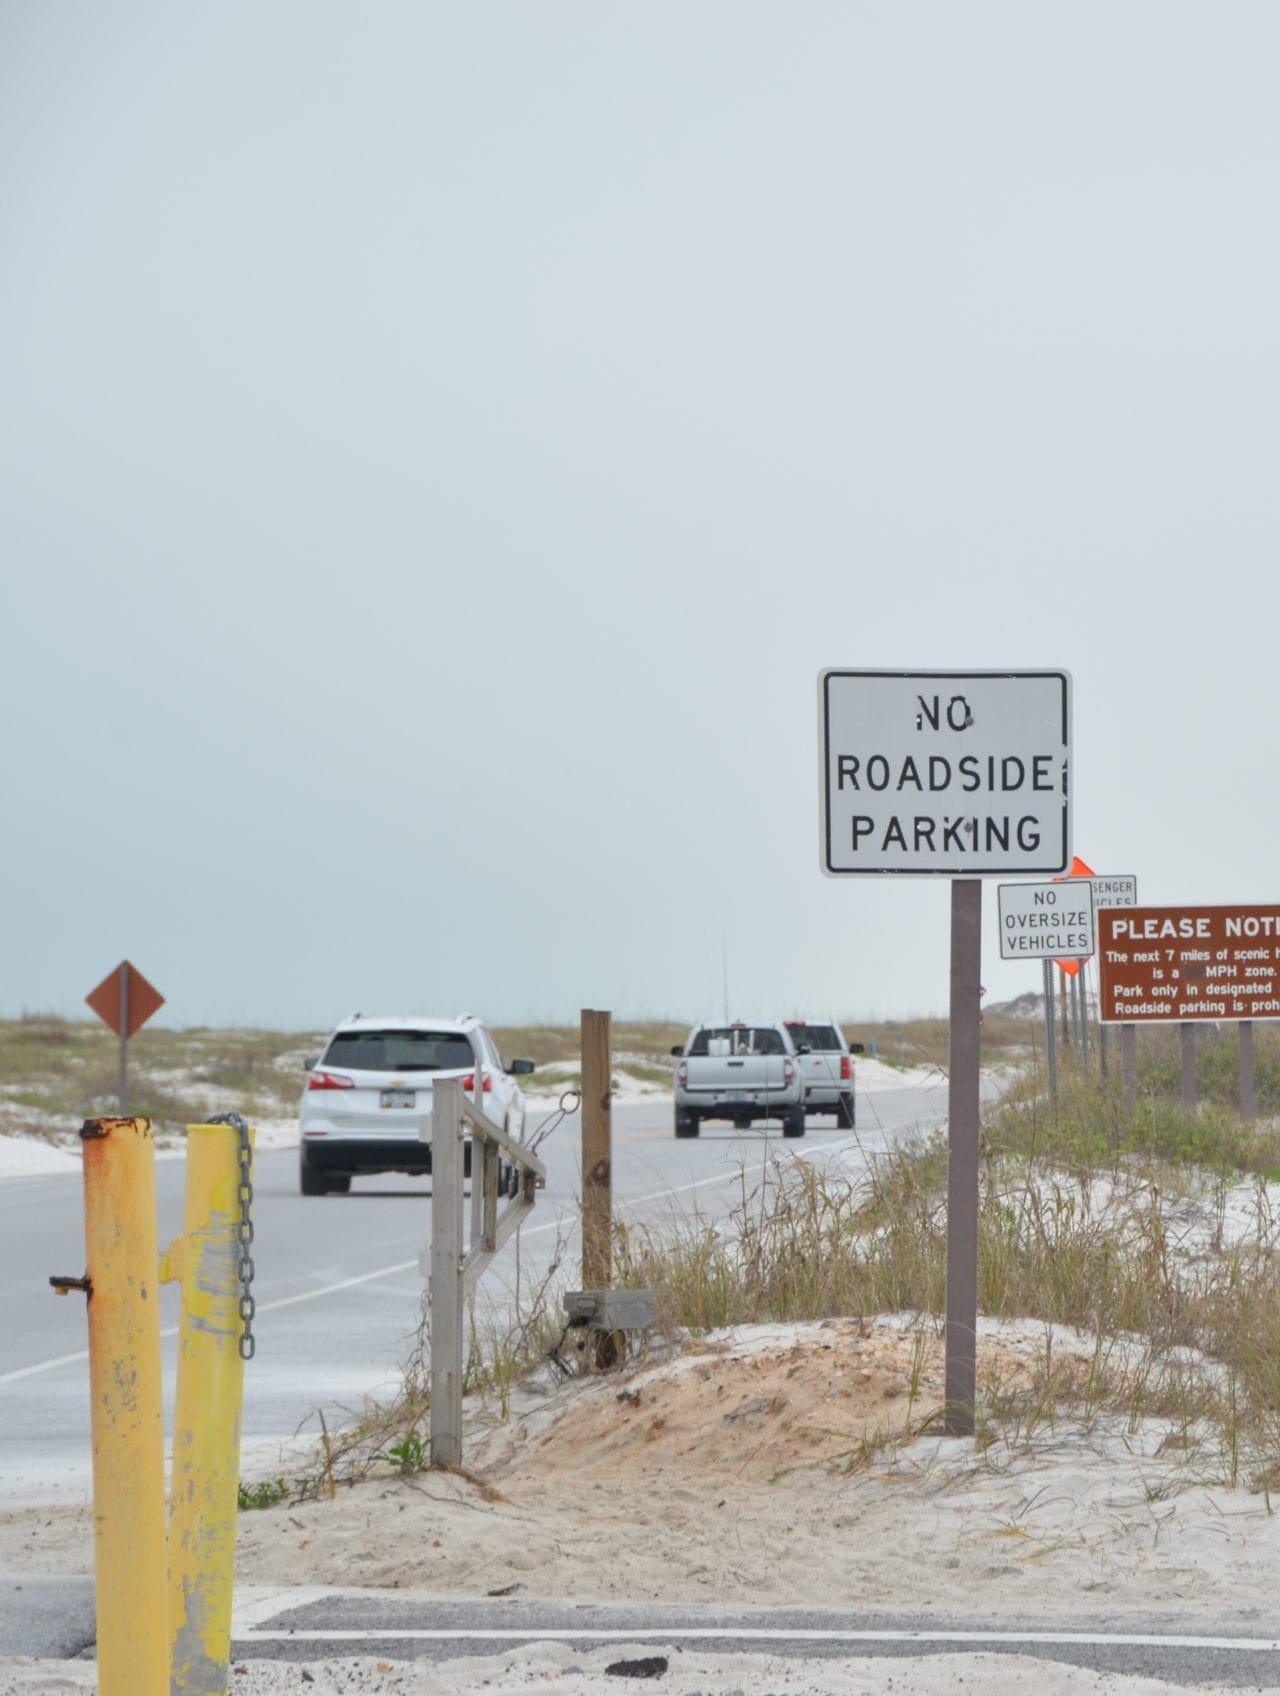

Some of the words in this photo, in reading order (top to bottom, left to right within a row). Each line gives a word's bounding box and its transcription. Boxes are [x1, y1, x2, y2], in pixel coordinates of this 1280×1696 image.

[916, 695, 973, 732] NO
[837, 754, 1055, 792] ROADSIDE
[851, 815, 1041, 852] PARKING
[1092, 881, 1133, 893] SENGER
[1034, 890, 1057, 906] NO
[1005, 911, 1088, 929] OVERSIZE
[1112, 918, 1212, 940] PLEASE
[1007, 933, 1089, 951] VEHICLES
[1106, 951, 1128, 964] The
[1133, 951, 1160, 962] next
[1165, 950, 1175, 961] 7
[1180, 949, 1210, 962] miles
[1216, 949, 1228, 961] of
[1234, 948, 1270, 960] scenic
[1153, 967, 1164, 979] is
[1171, 969, 1180, 979] a
[1206, 966, 1237, 978] MPH
[1245, 965, 1278, 977] zone.
[1114, 984, 1143, 997] Park
[1151, 984, 1178, 999] only
[1186, 983, 1198, 996] in
[1206, 982, 1272, 997] designated
[1115, 1001, 1172, 1014] Roadside
[1179, 1001, 1226, 1015] parking
[1233, 999, 1244, 1012] is
